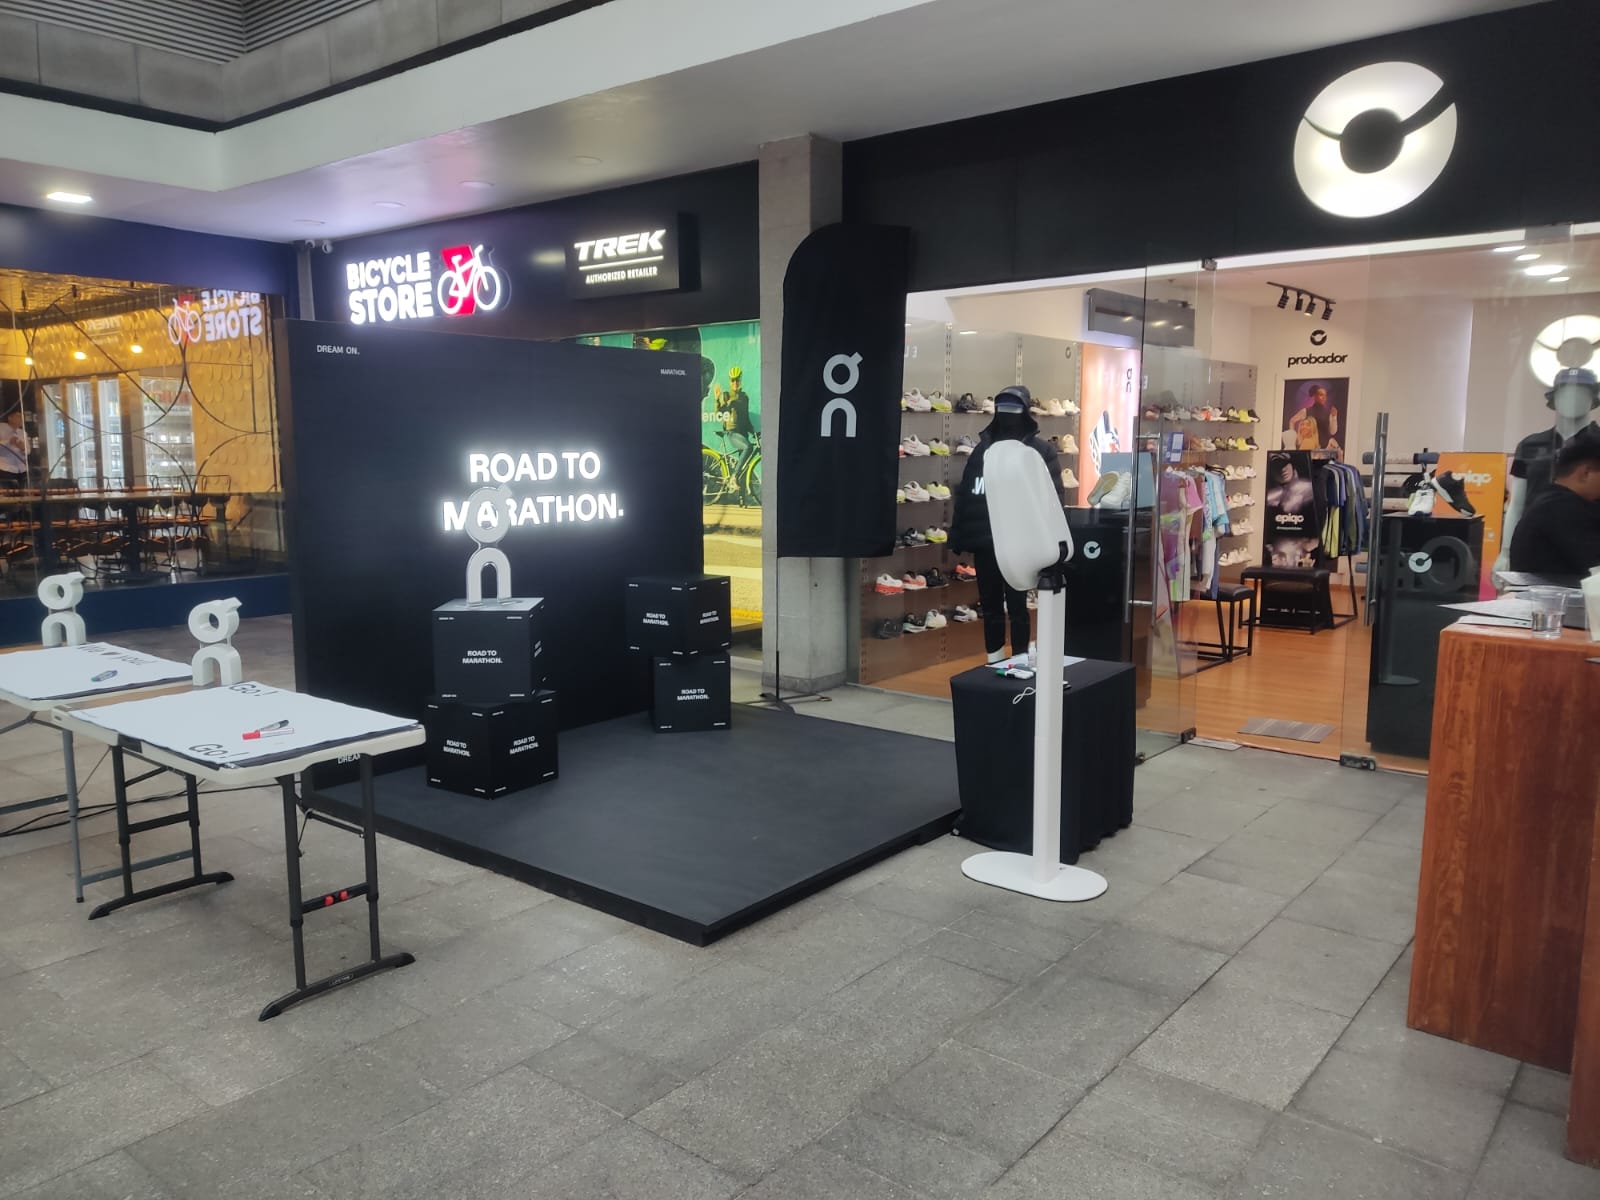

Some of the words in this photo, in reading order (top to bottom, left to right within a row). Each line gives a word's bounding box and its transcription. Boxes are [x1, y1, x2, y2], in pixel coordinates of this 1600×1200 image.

[574, 229, 666, 261] TREK
[346, 251, 431, 290] BICYCLE
[585, 270, 626, 285] AUTHORIZED
[627, 266, 658, 279] RETAILER
[348, 281, 434, 325] STORE
[316, 344, 344, 353] DREAM
[345, 346, 360, 355] ON.
[1287, 352, 1348, 368] probador
[469, 453, 558, 483] ROAD
[562, 451, 601, 480] TO
